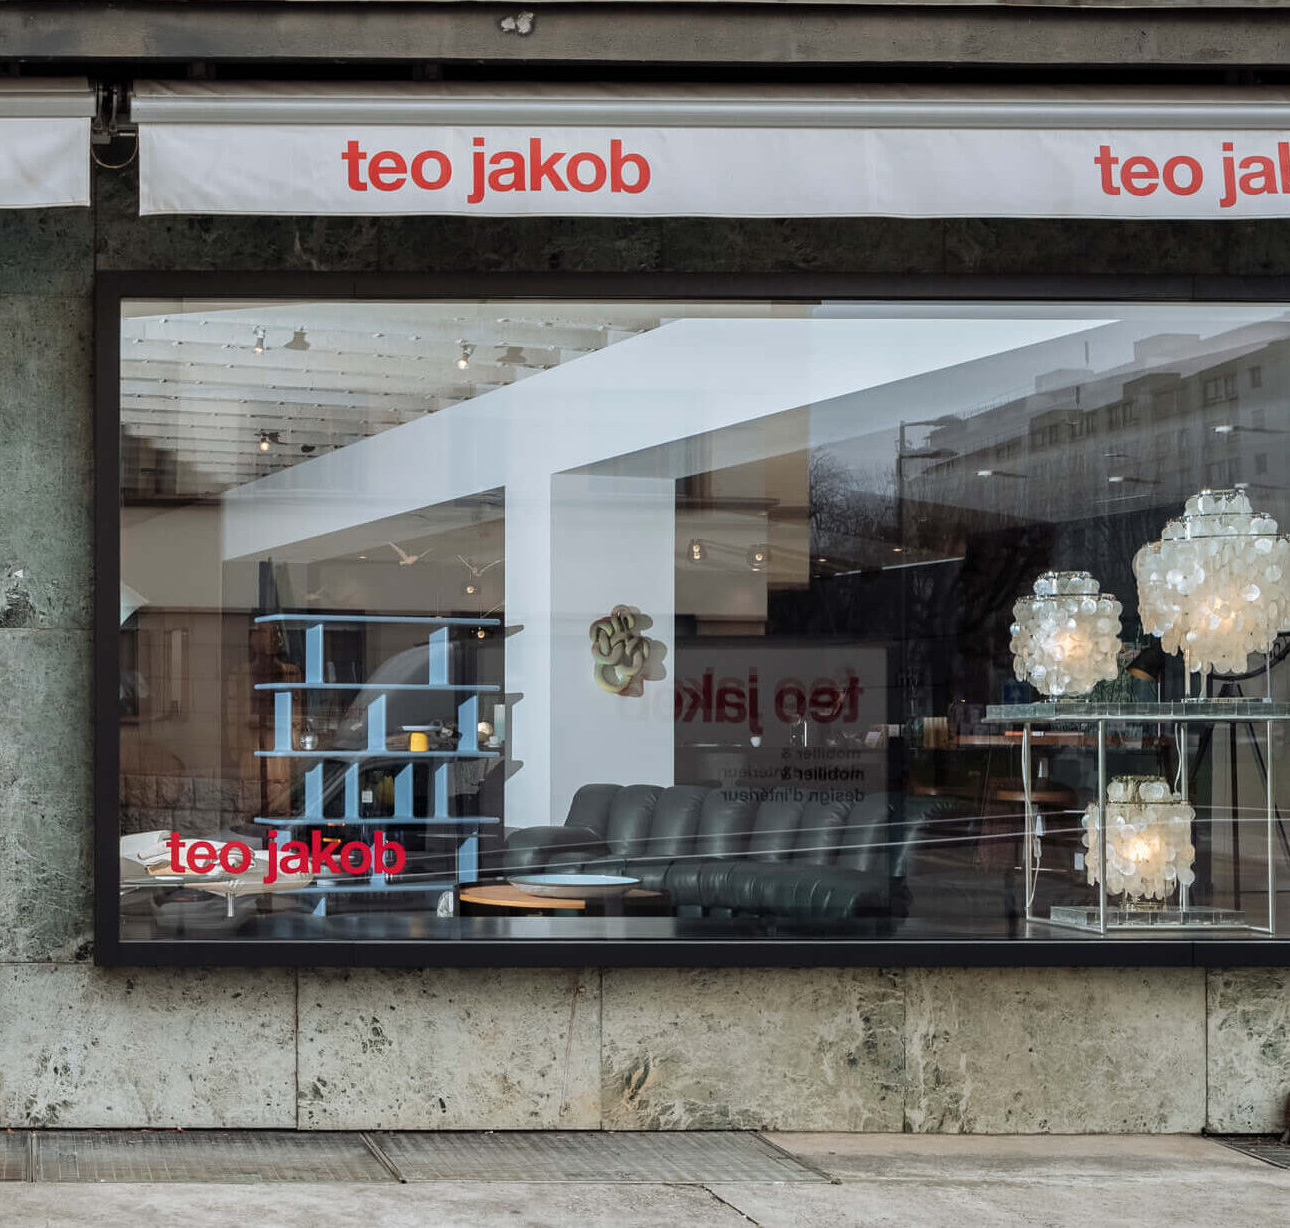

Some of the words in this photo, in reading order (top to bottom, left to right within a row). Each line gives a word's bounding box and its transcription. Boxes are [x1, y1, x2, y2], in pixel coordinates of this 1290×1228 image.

[341, 140, 453, 192] teo
[467, 137, 651, 204] jakob
[1094, 145, 1204, 197] teo
[166, 831, 252, 875] teo
[263, 829, 407, 885] jakob
